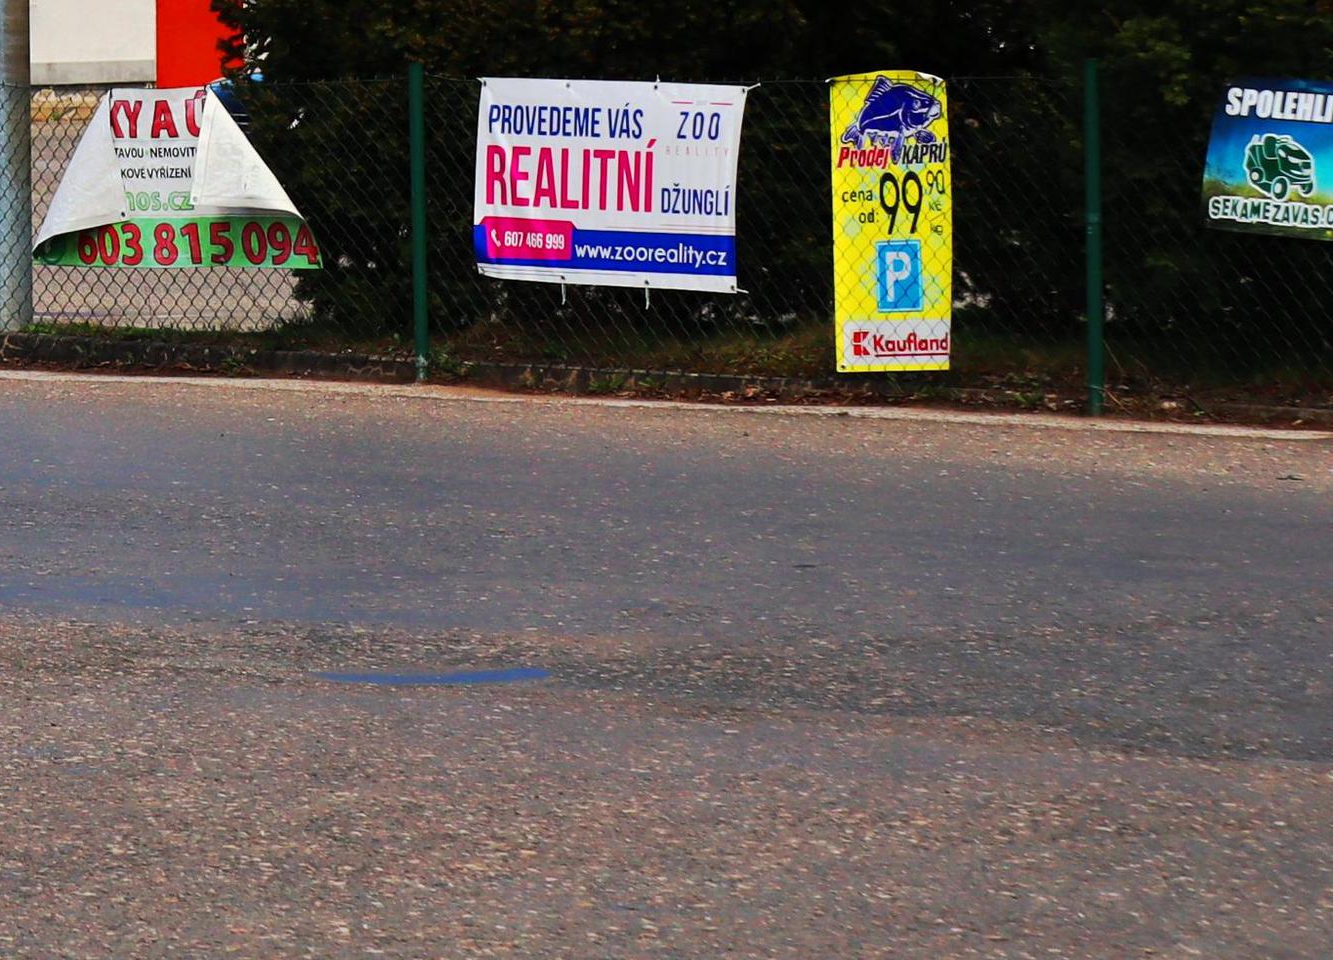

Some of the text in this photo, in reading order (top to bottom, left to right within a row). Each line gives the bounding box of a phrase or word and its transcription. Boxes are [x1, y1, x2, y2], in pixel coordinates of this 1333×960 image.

[151, 99, 179, 139] A
[488, 102, 643, 140] PROVEDEME VÁS
[677, 111, 721, 140] ZOO
[150, 146, 198, 159] NEMOVIT
[837, 146, 890, 170] Prodej
[485, 138, 730, 216] REALITNÍ DŽUNGLÍ
[842, 189, 873, 203] cena
[879, 171, 923, 235] 99
[77, 220, 320, 266] 603 815 094
[504, 231, 524, 248] 607
[545, 233, 565, 250] 999
[575, 242, 727, 268] www.zooreality.cz
[885, 251, 912, 302] P
[873, 332, 949, 353] Kaufland
